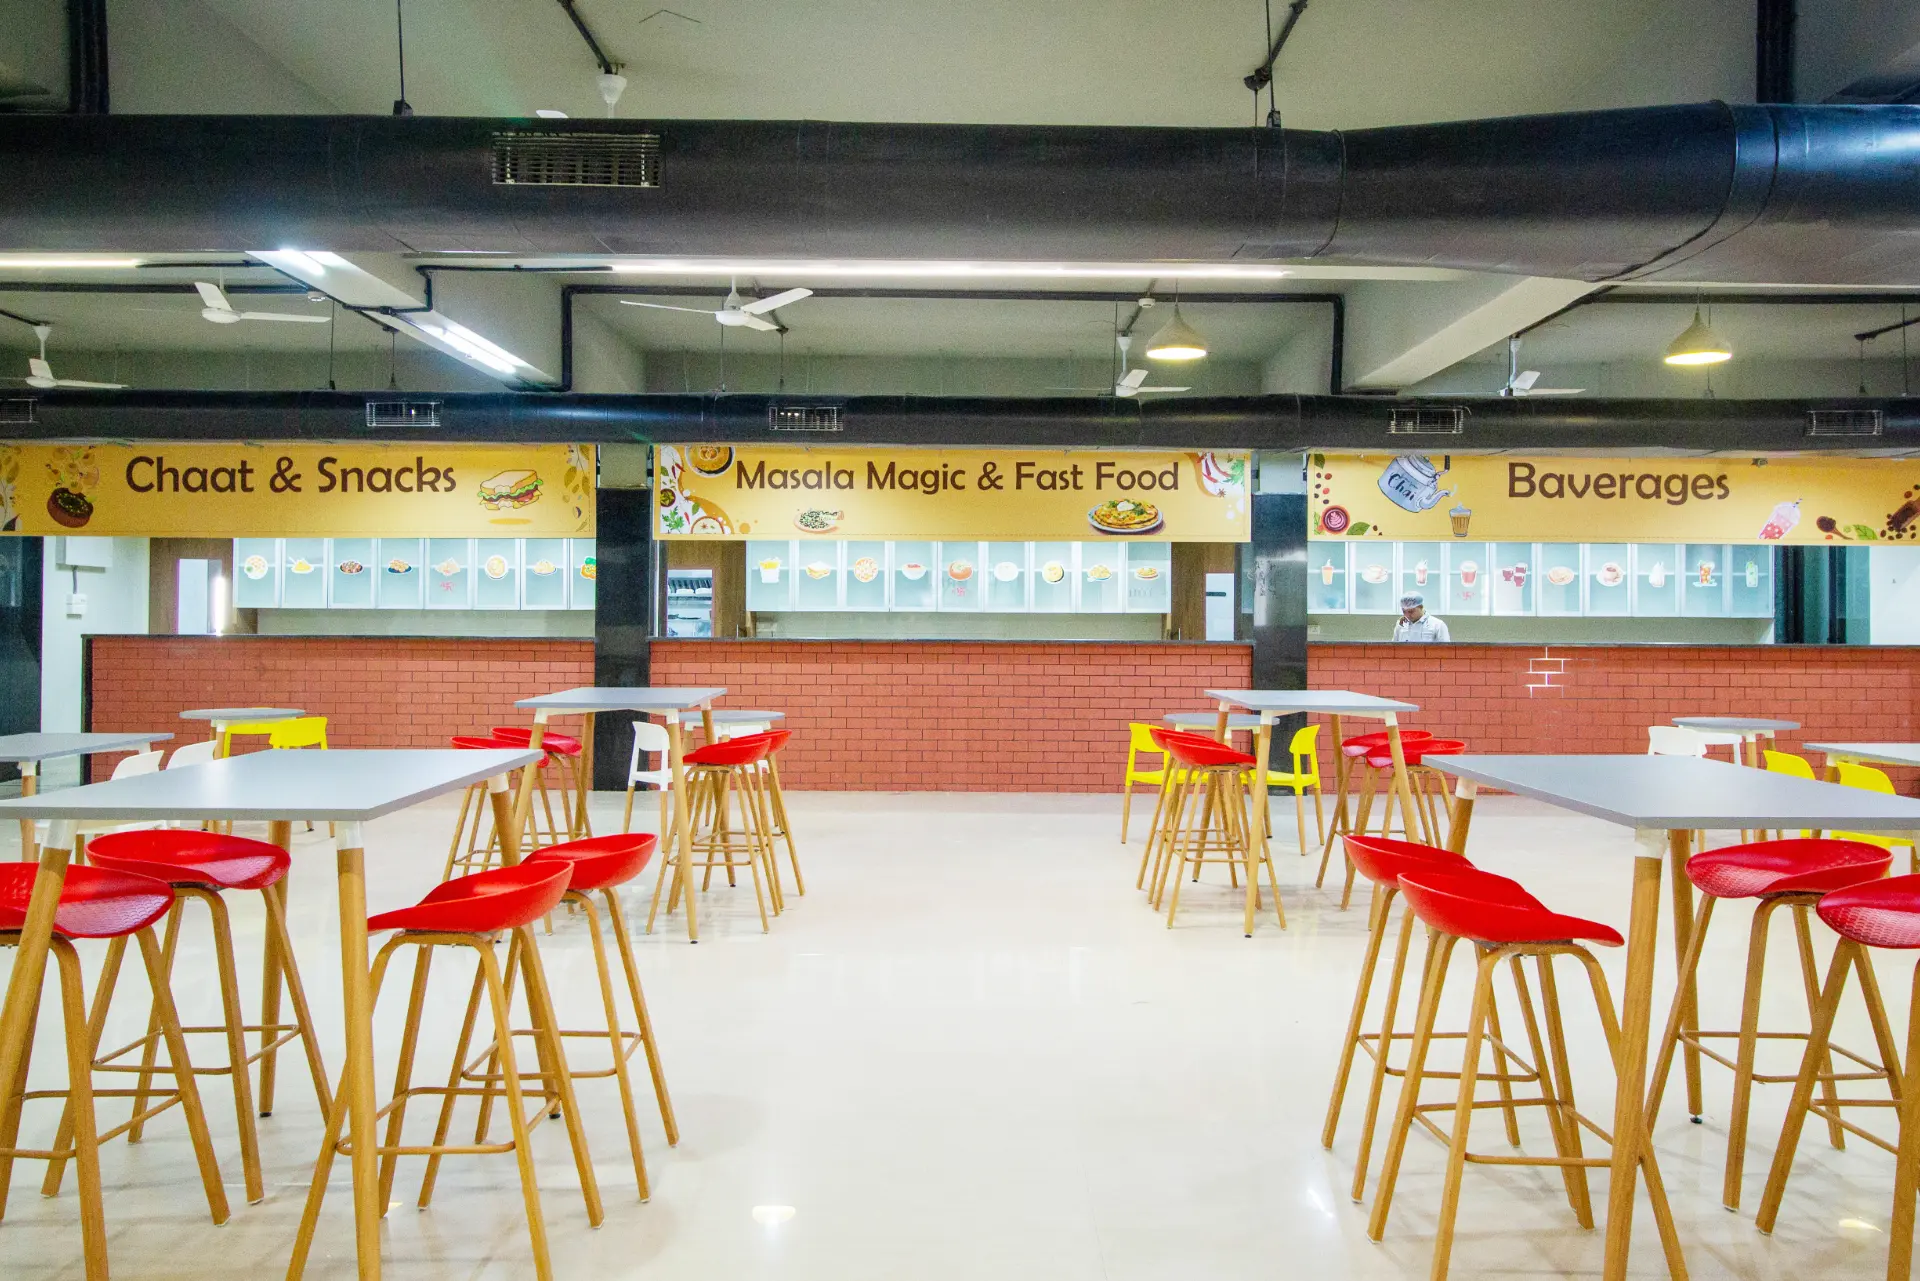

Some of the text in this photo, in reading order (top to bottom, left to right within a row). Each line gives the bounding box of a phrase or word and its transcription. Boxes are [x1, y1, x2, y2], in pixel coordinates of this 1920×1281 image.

[126, 456, 456, 493] Chaat & Snacks
[737, 461, 1178, 495] Masala Magic & Fast Food
[1388, 473, 1415, 501] Chai
[1508, 462, 1730, 505] Baverages
